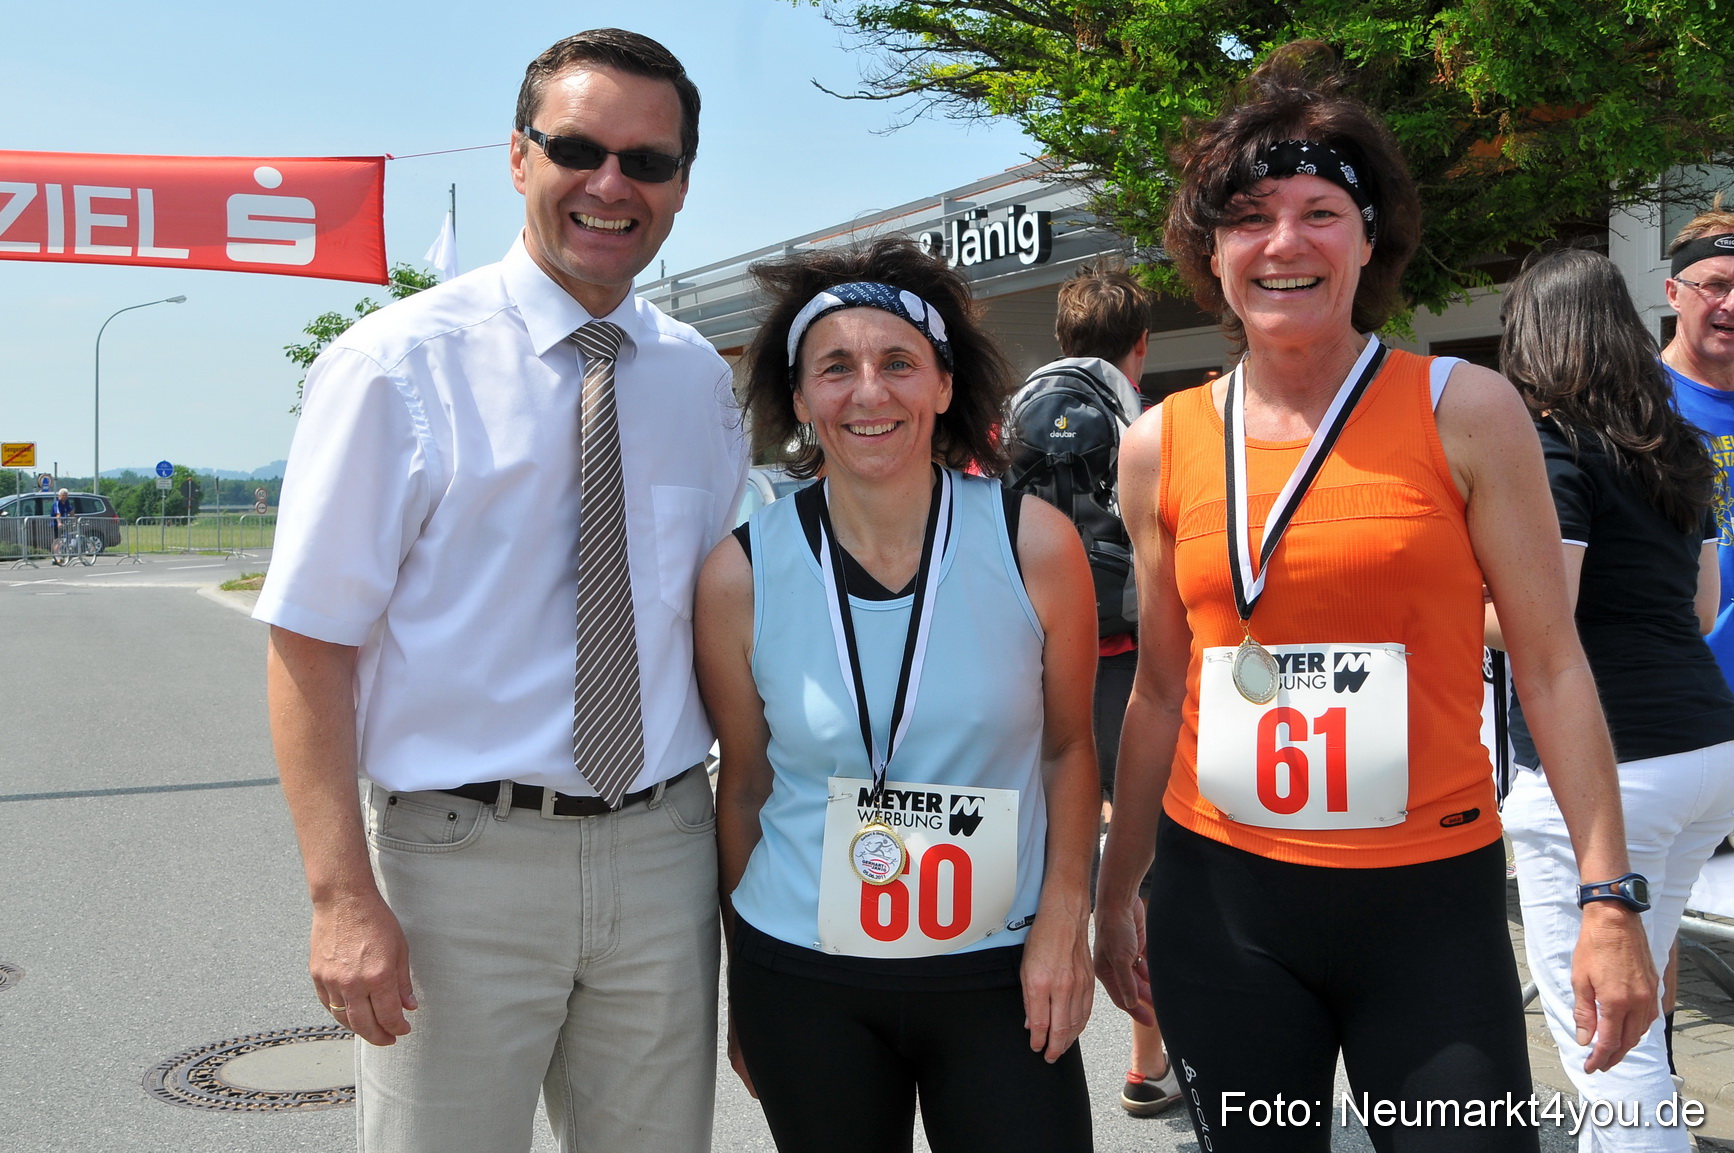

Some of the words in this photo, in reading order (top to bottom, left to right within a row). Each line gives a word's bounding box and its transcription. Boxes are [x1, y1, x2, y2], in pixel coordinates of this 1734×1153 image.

[0, 181, 190, 260] ZIEL
[947, 204, 1041, 269] Jänig
[1049, 430, 1077, 438] deuter
[1256, 706, 1348, 815] 61
[857, 787, 943, 813] MEYER
[859, 843, 973, 942] 60
